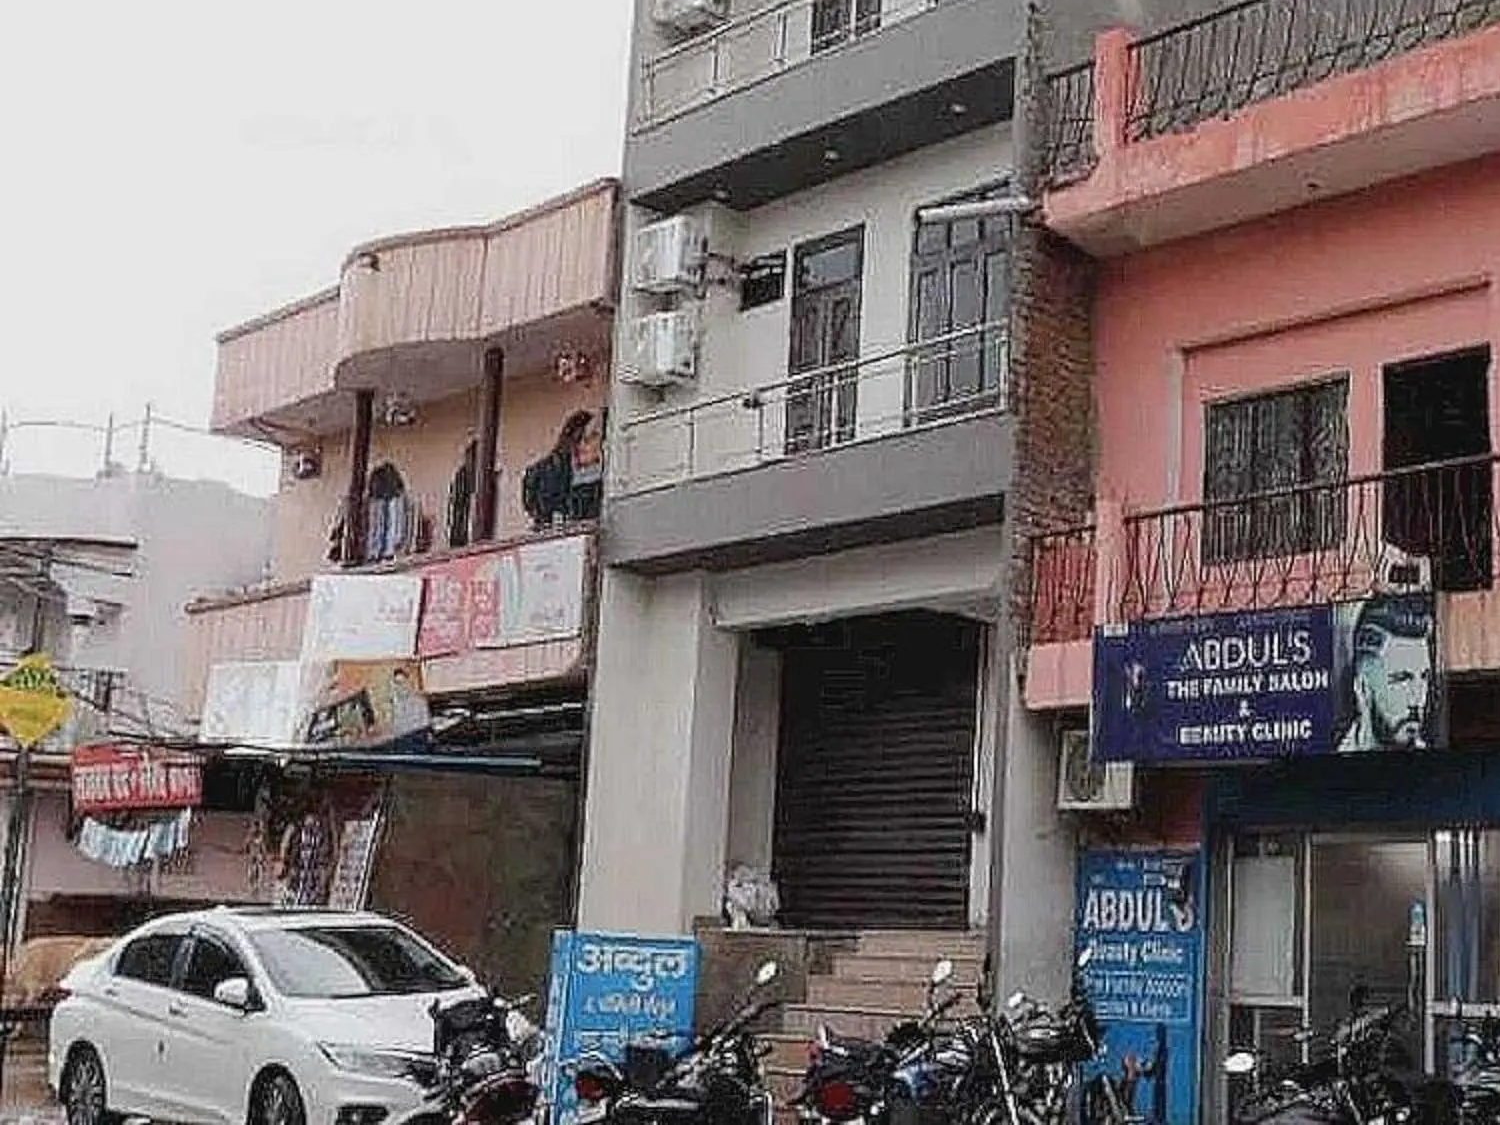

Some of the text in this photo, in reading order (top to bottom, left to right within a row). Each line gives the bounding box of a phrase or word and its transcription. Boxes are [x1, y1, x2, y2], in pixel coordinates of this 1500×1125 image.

[1167, 679, 1199, 699] THE
[1203, 675, 1264, 695] FAMILY
[1252, 718, 1312, 742] CLINIC
[1084, 887, 1194, 932] ABDULS
